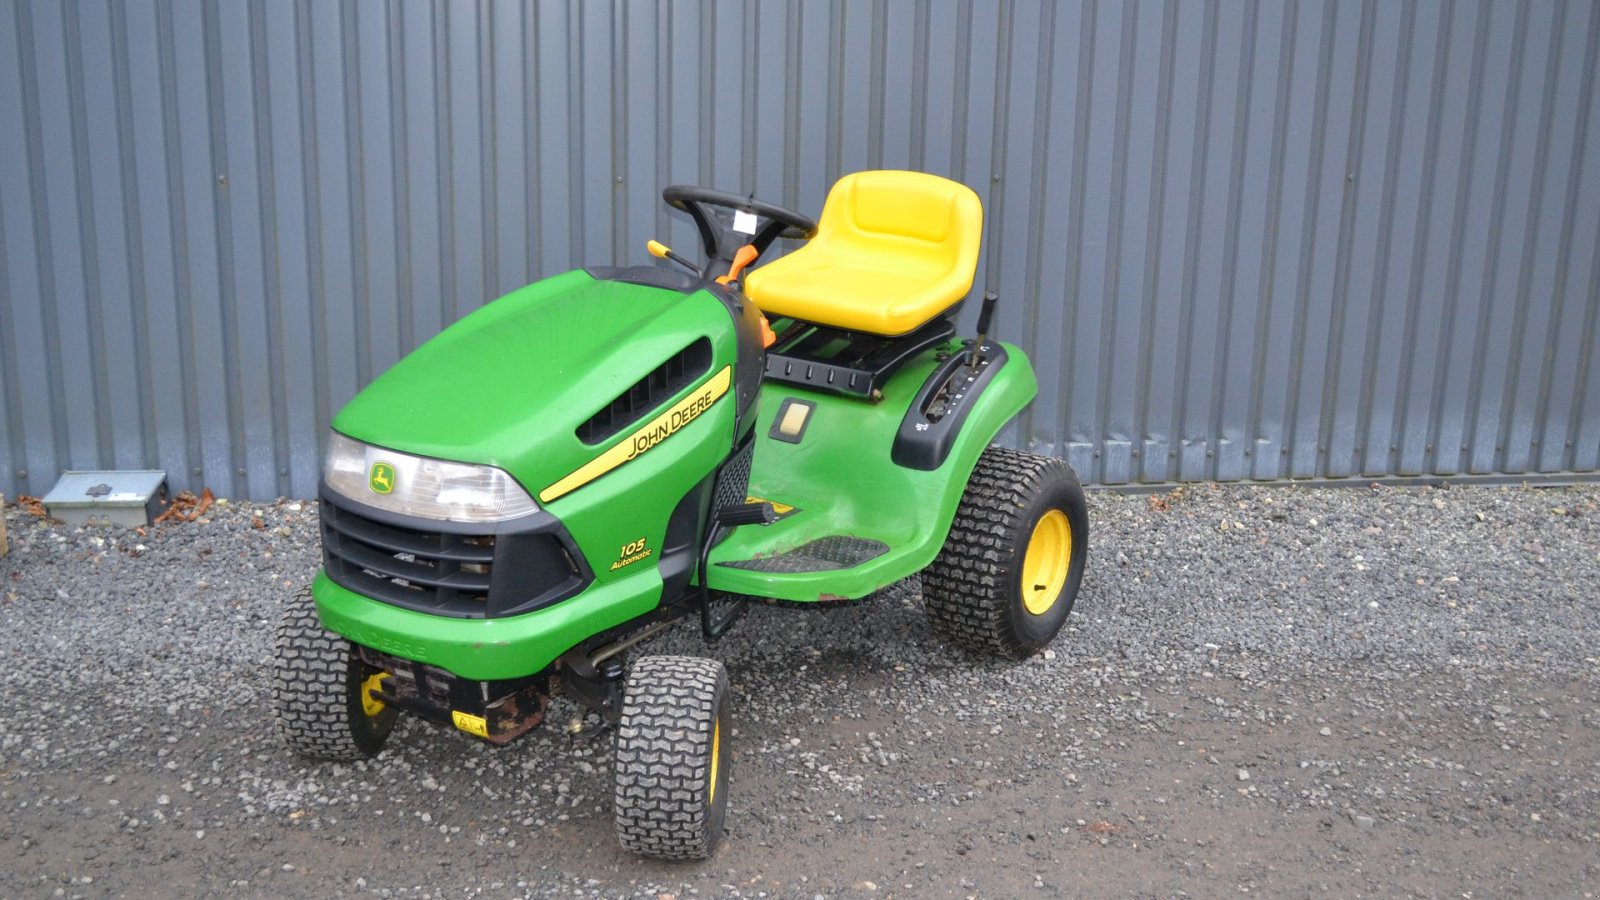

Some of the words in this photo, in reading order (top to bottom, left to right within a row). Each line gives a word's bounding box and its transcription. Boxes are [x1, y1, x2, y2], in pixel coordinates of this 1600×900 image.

[628, 421, 669, 458] JOHN
[671, 391, 713, 430] DEERE
[620, 537, 646, 558] 105
[610, 549, 652, 571] Automatic
